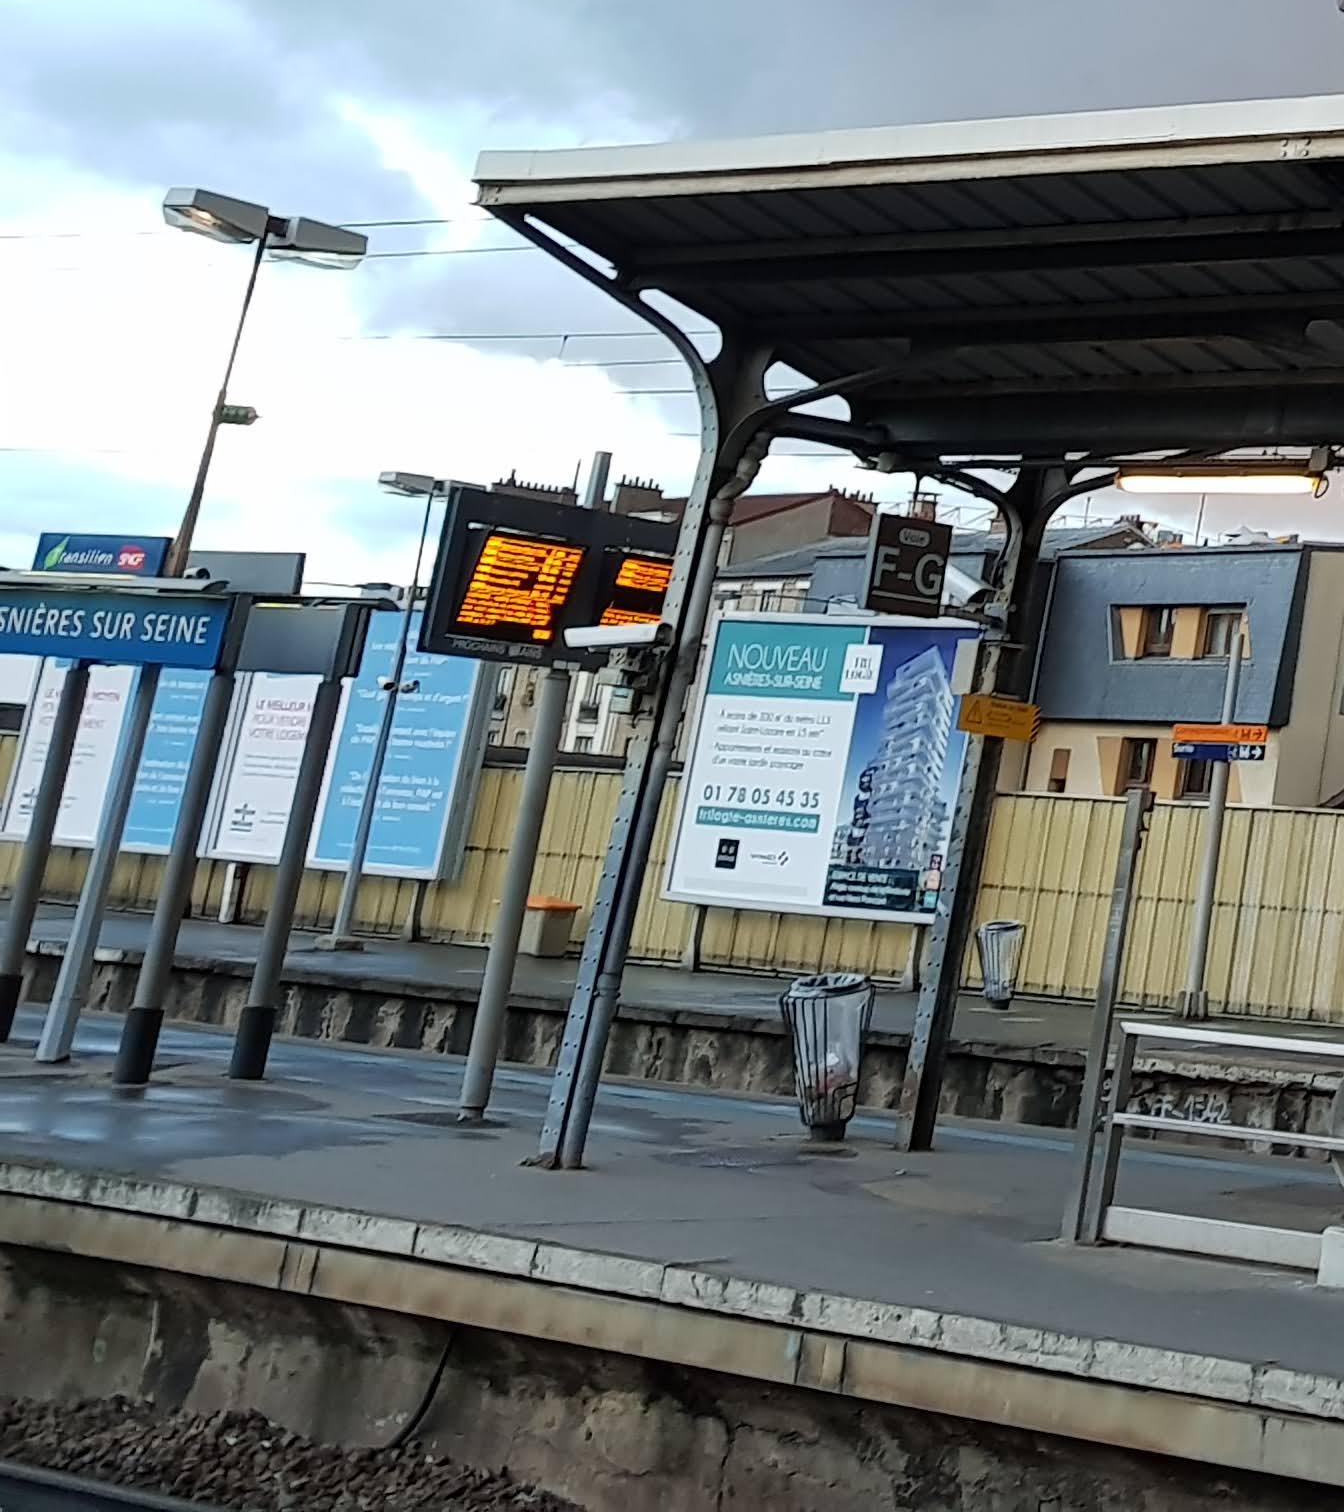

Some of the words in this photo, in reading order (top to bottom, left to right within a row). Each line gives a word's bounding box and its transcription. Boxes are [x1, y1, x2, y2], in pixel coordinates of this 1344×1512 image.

[90, 611, 136, 641] SUR
[141, 613, 211, 645] SEINE
[727, 643, 829, 673] NOUVEAU
[703, 784, 721, 801] 01
[727, 786, 746, 803] 78
[751, 787, 771, 805] 05
[775, 789, 795, 807] 45
[799, 791, 820, 809] 35
